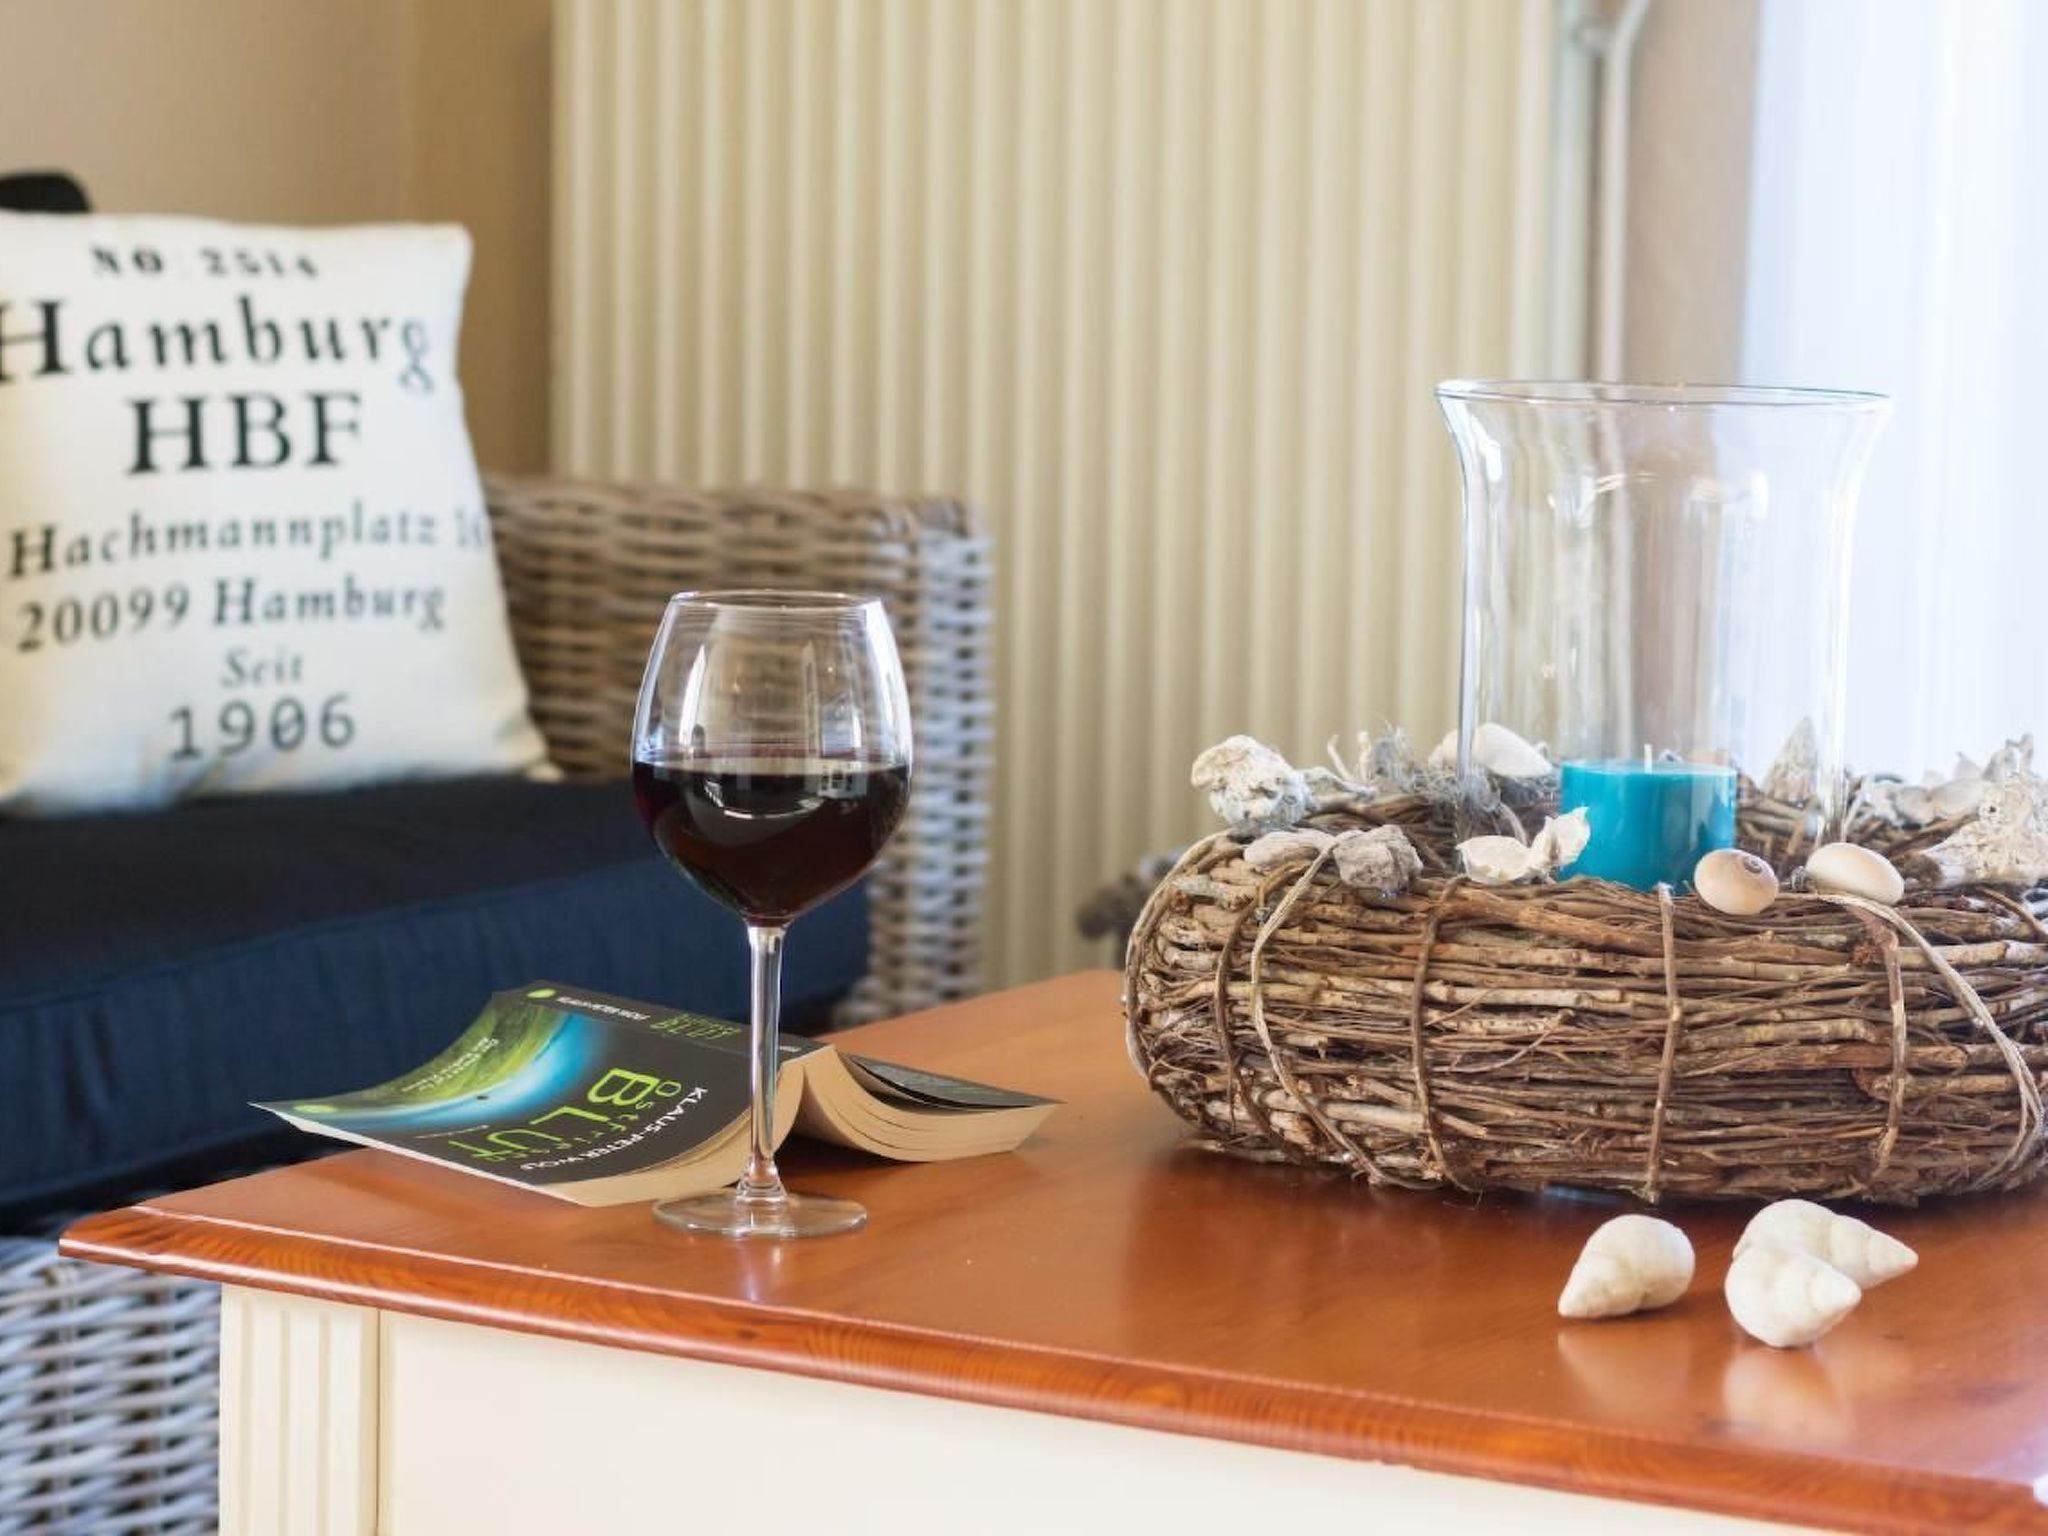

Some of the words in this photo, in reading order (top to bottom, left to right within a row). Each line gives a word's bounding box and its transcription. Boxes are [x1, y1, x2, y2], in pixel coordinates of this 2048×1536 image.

[0, 294, 434, 394] Hamburg
[126, 390, 363, 477] HBF
[7, 501, 438, 580] Hachmannplatz
[17, 585, 191, 654] 20099
[212, 574, 445, 631] Hamburg
[221, 648, 303, 688] Seit
[167, 694, 355, 762] 1906
[447, 1068, 660, 1158] BLUT
[580, 1085, 708, 1158] KLAUS-PETER
